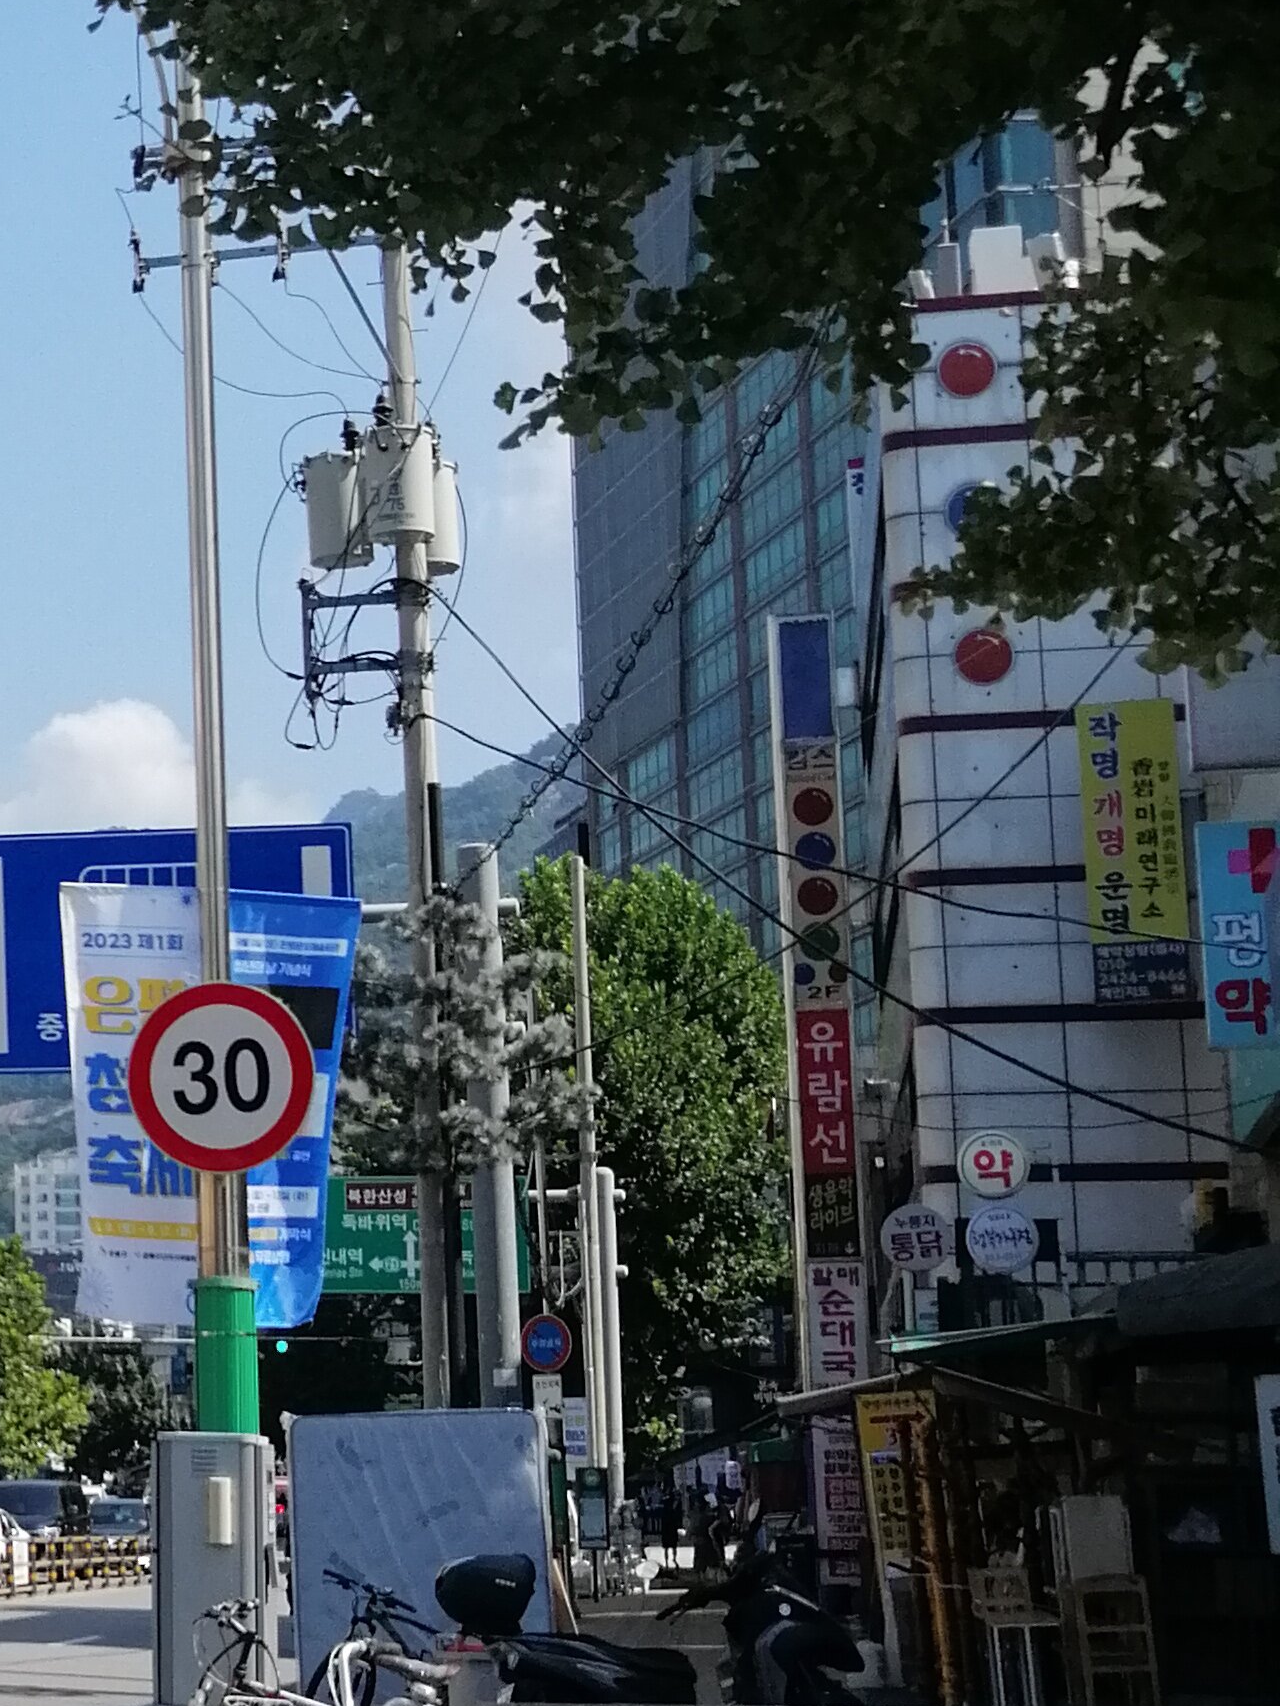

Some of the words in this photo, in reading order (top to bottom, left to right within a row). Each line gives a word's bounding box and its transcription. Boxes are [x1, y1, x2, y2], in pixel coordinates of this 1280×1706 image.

[1089, 712, 1122, 779] 작명
[1093, 789, 1124, 856] 개명
[1095, 872, 1133, 935] 운명
[82, 932, 132, 950] 2023
[138, 934, 184, 951] 제1회
[807, 985, 839, 999] 2F
[1215, 977, 1271, 1035] 약
[172, 1038, 270, 1115] 30
[803, 1022, 849, 1165] 유람선
[973, 1148, 1014, 1187] 약
[348, 1188, 407, 1204] 북한산성
[341, 1213, 407, 1232] 독바위역
[809, 1204, 856, 1232] 라이브
[890, 1230, 943, 1262] 통닭
[813, 1265, 860, 1288] 할매
[819, 1288, 858, 1380] 순대국
